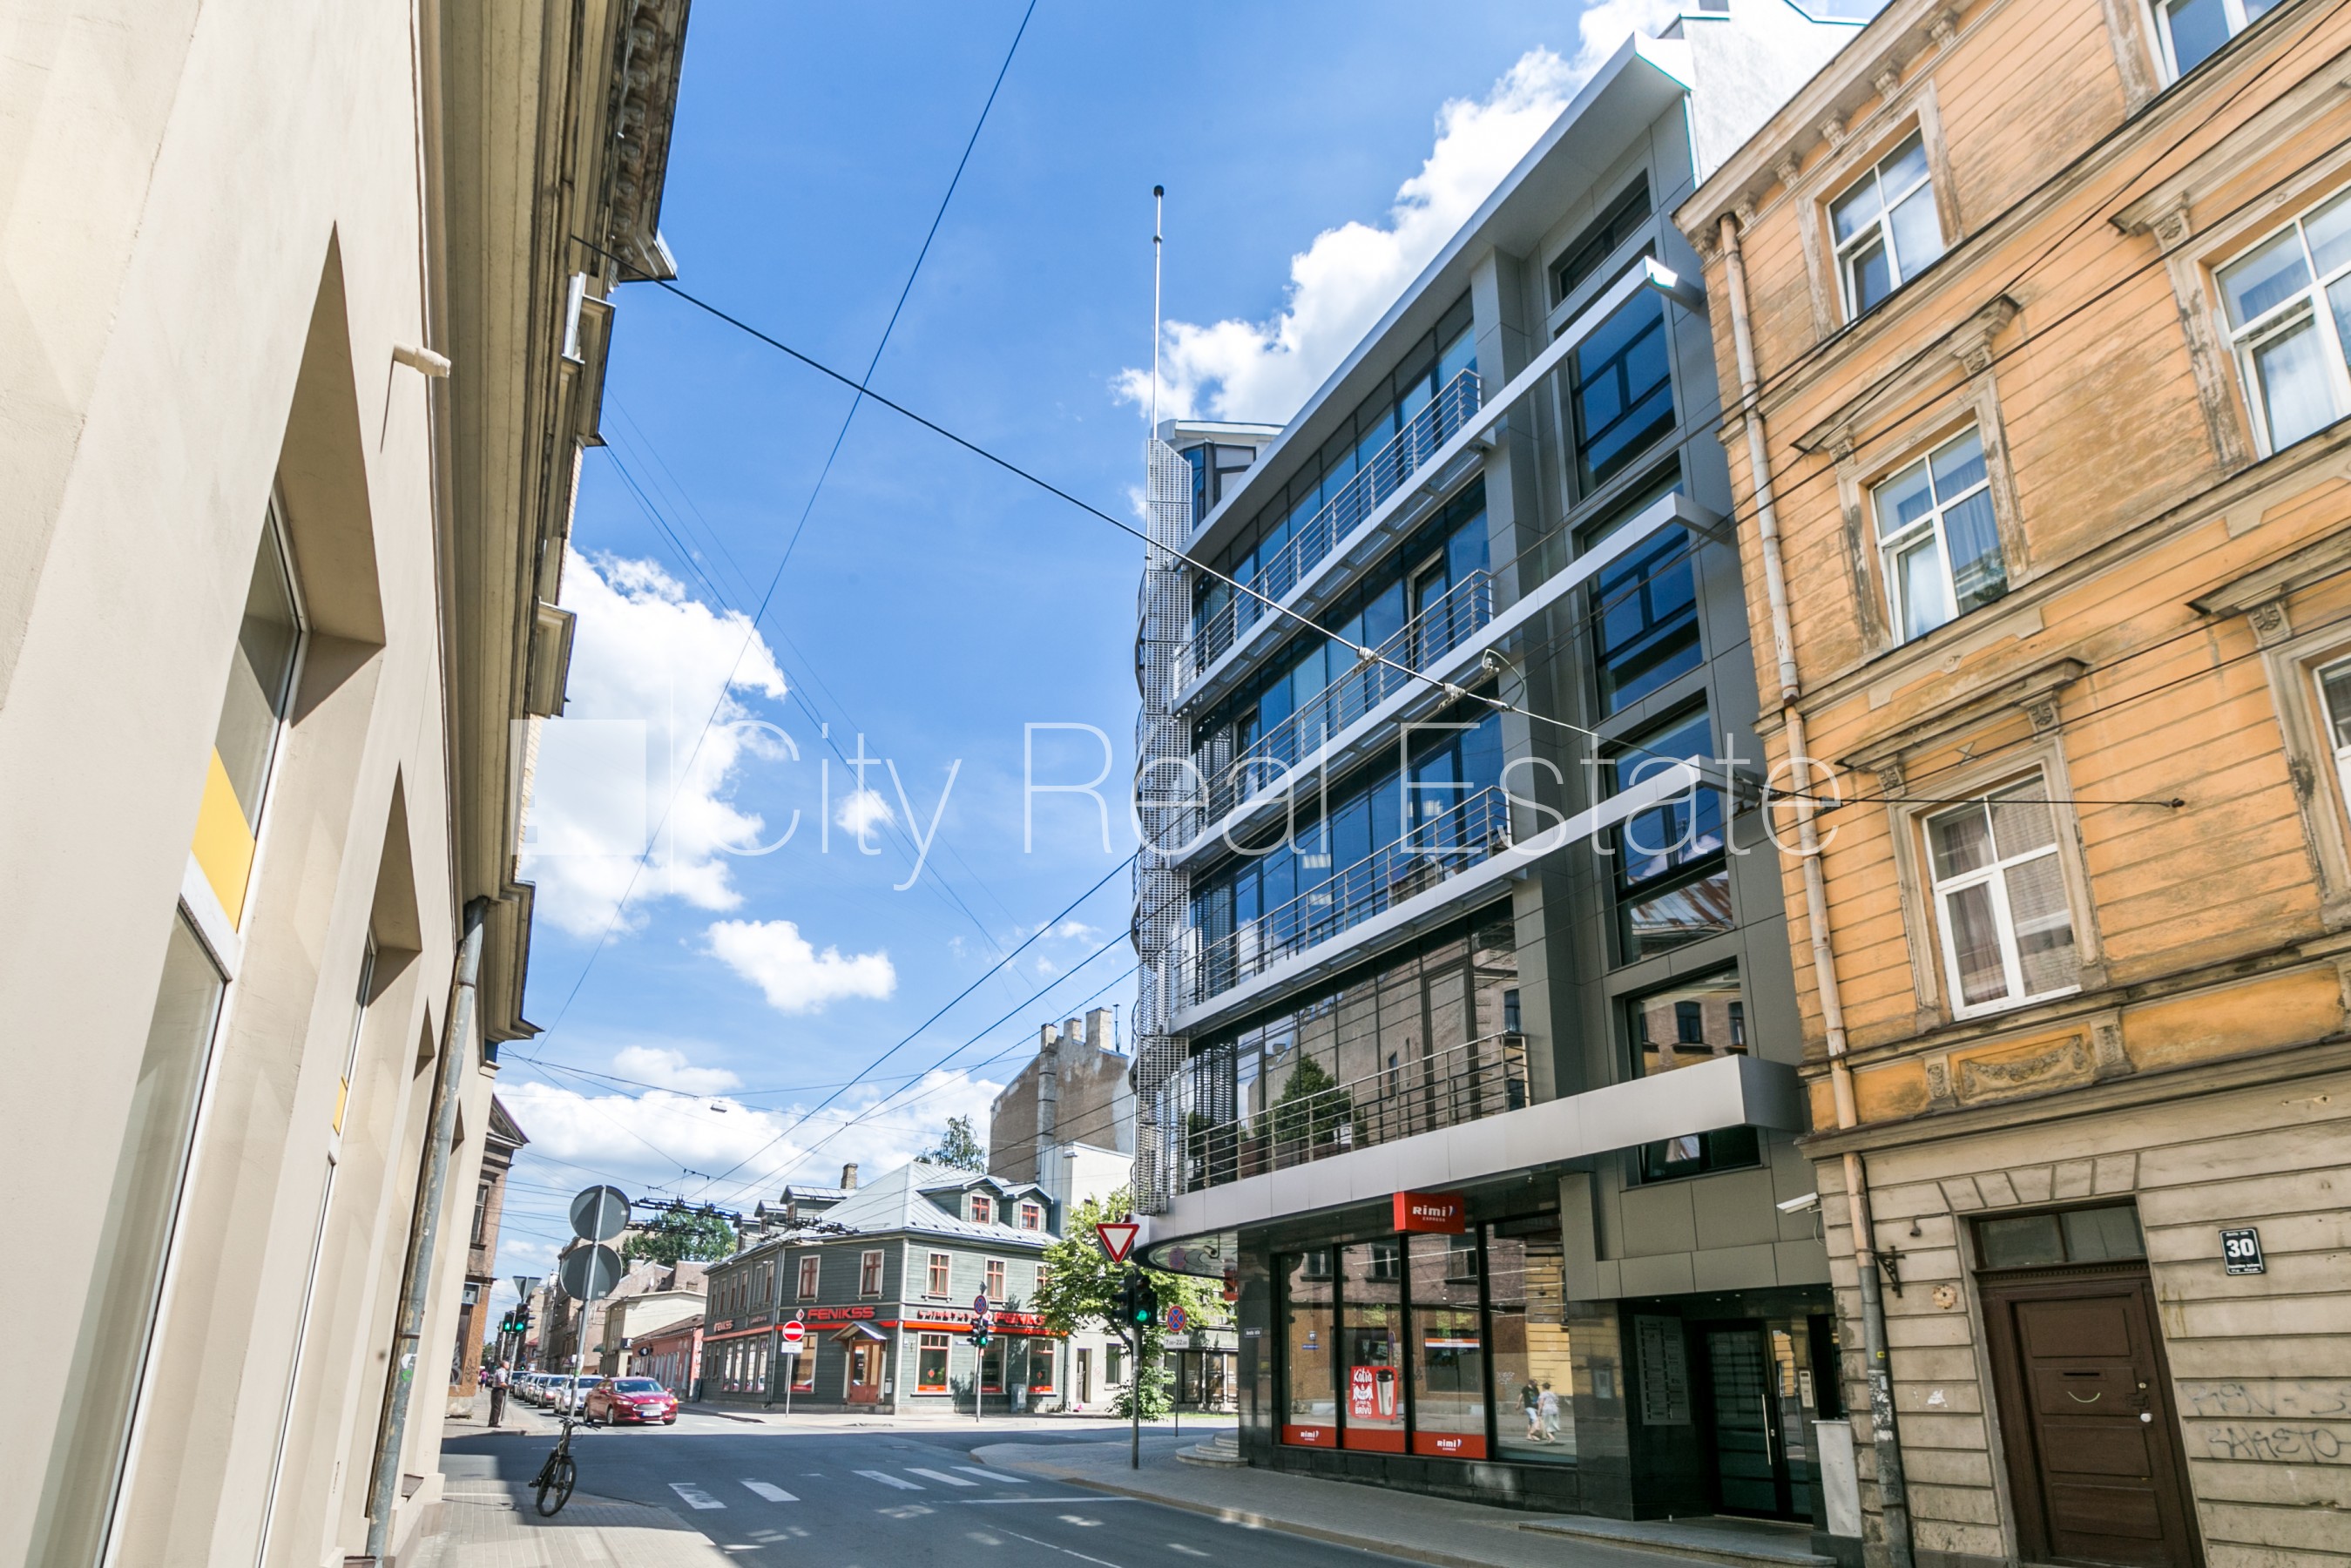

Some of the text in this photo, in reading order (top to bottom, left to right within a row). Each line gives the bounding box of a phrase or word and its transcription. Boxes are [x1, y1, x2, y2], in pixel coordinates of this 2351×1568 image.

[2226, 1238, 2255, 1258] 30
[807, 1307, 875, 1320] FENIKSS
[994, 1311, 1046, 1326] FENIKS
